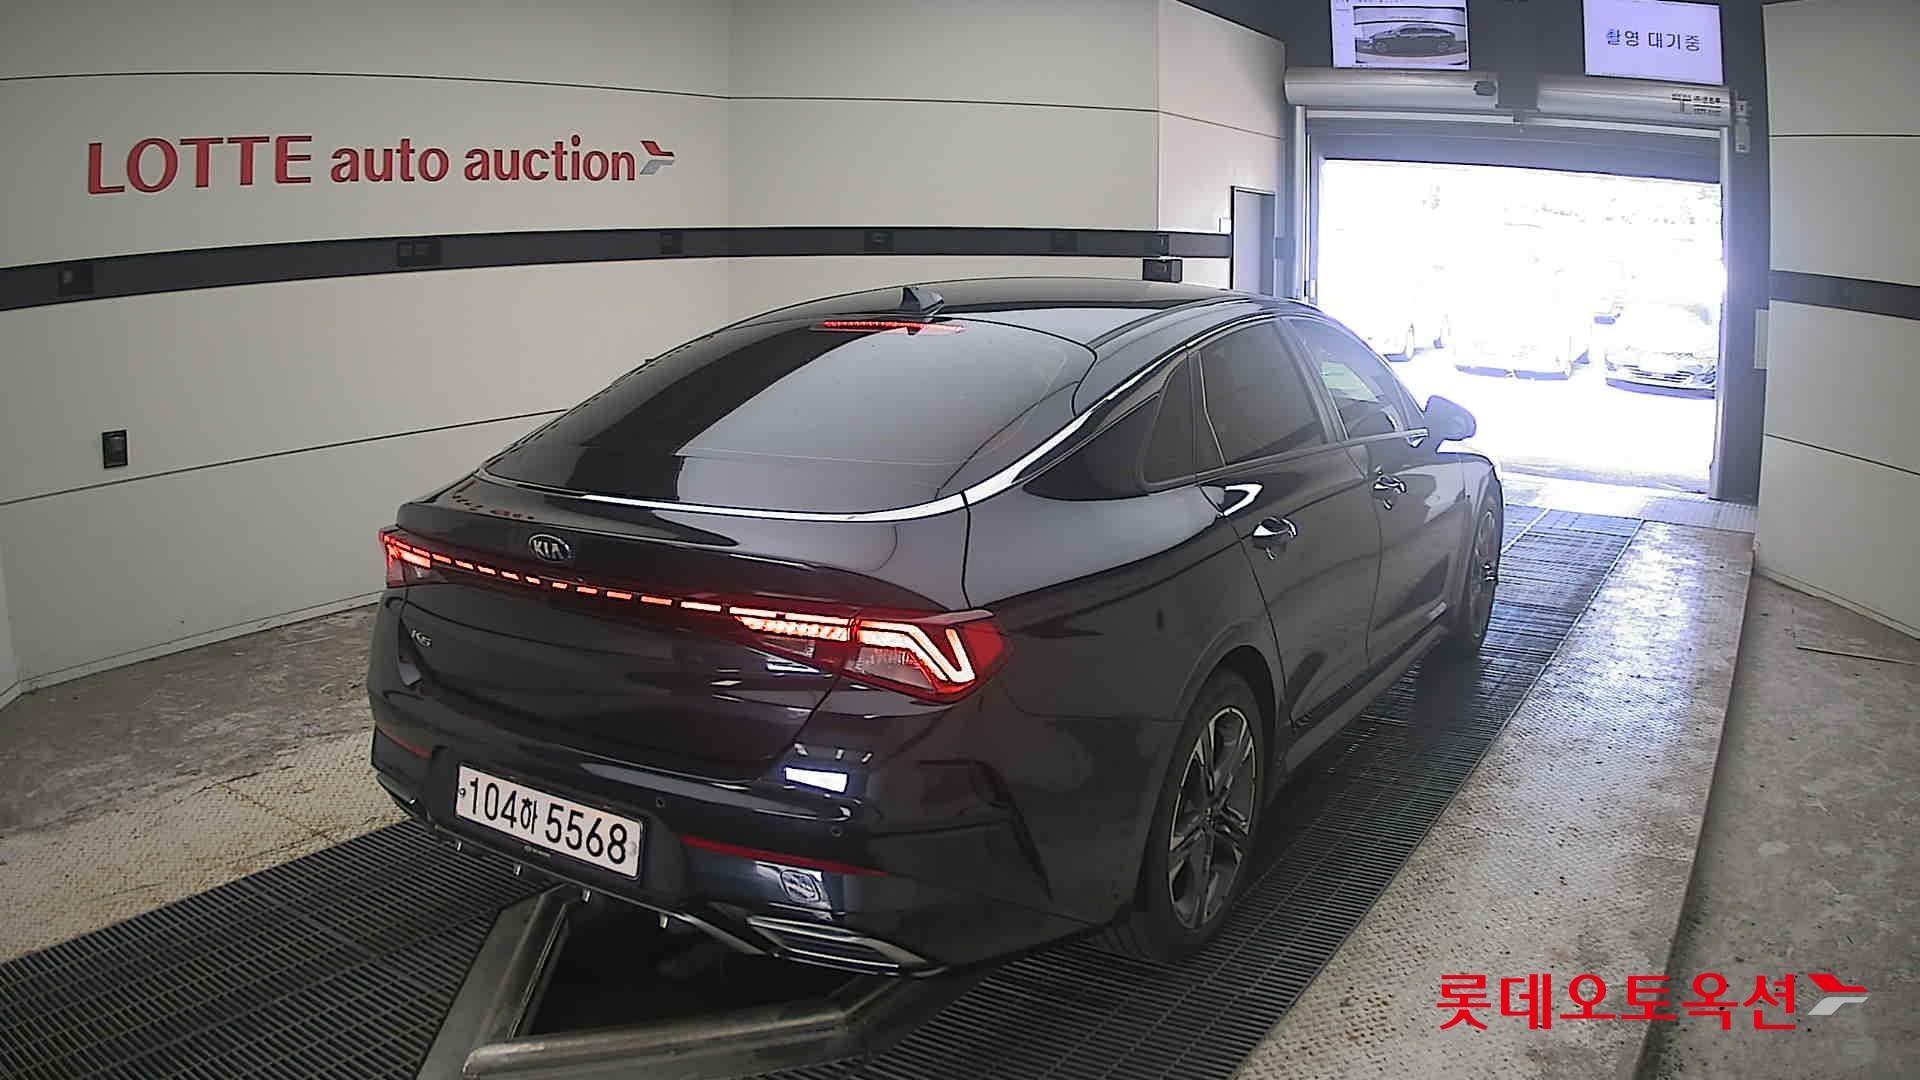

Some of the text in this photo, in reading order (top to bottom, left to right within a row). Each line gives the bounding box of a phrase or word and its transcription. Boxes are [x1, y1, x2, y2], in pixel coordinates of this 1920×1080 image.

[1648, 32, 1701, 52] 대기중
[88, 135, 636, 195] LOTTE auto auction
[533, 540, 565, 560] KIA
[470, 777, 627, 865] 104하 5568
